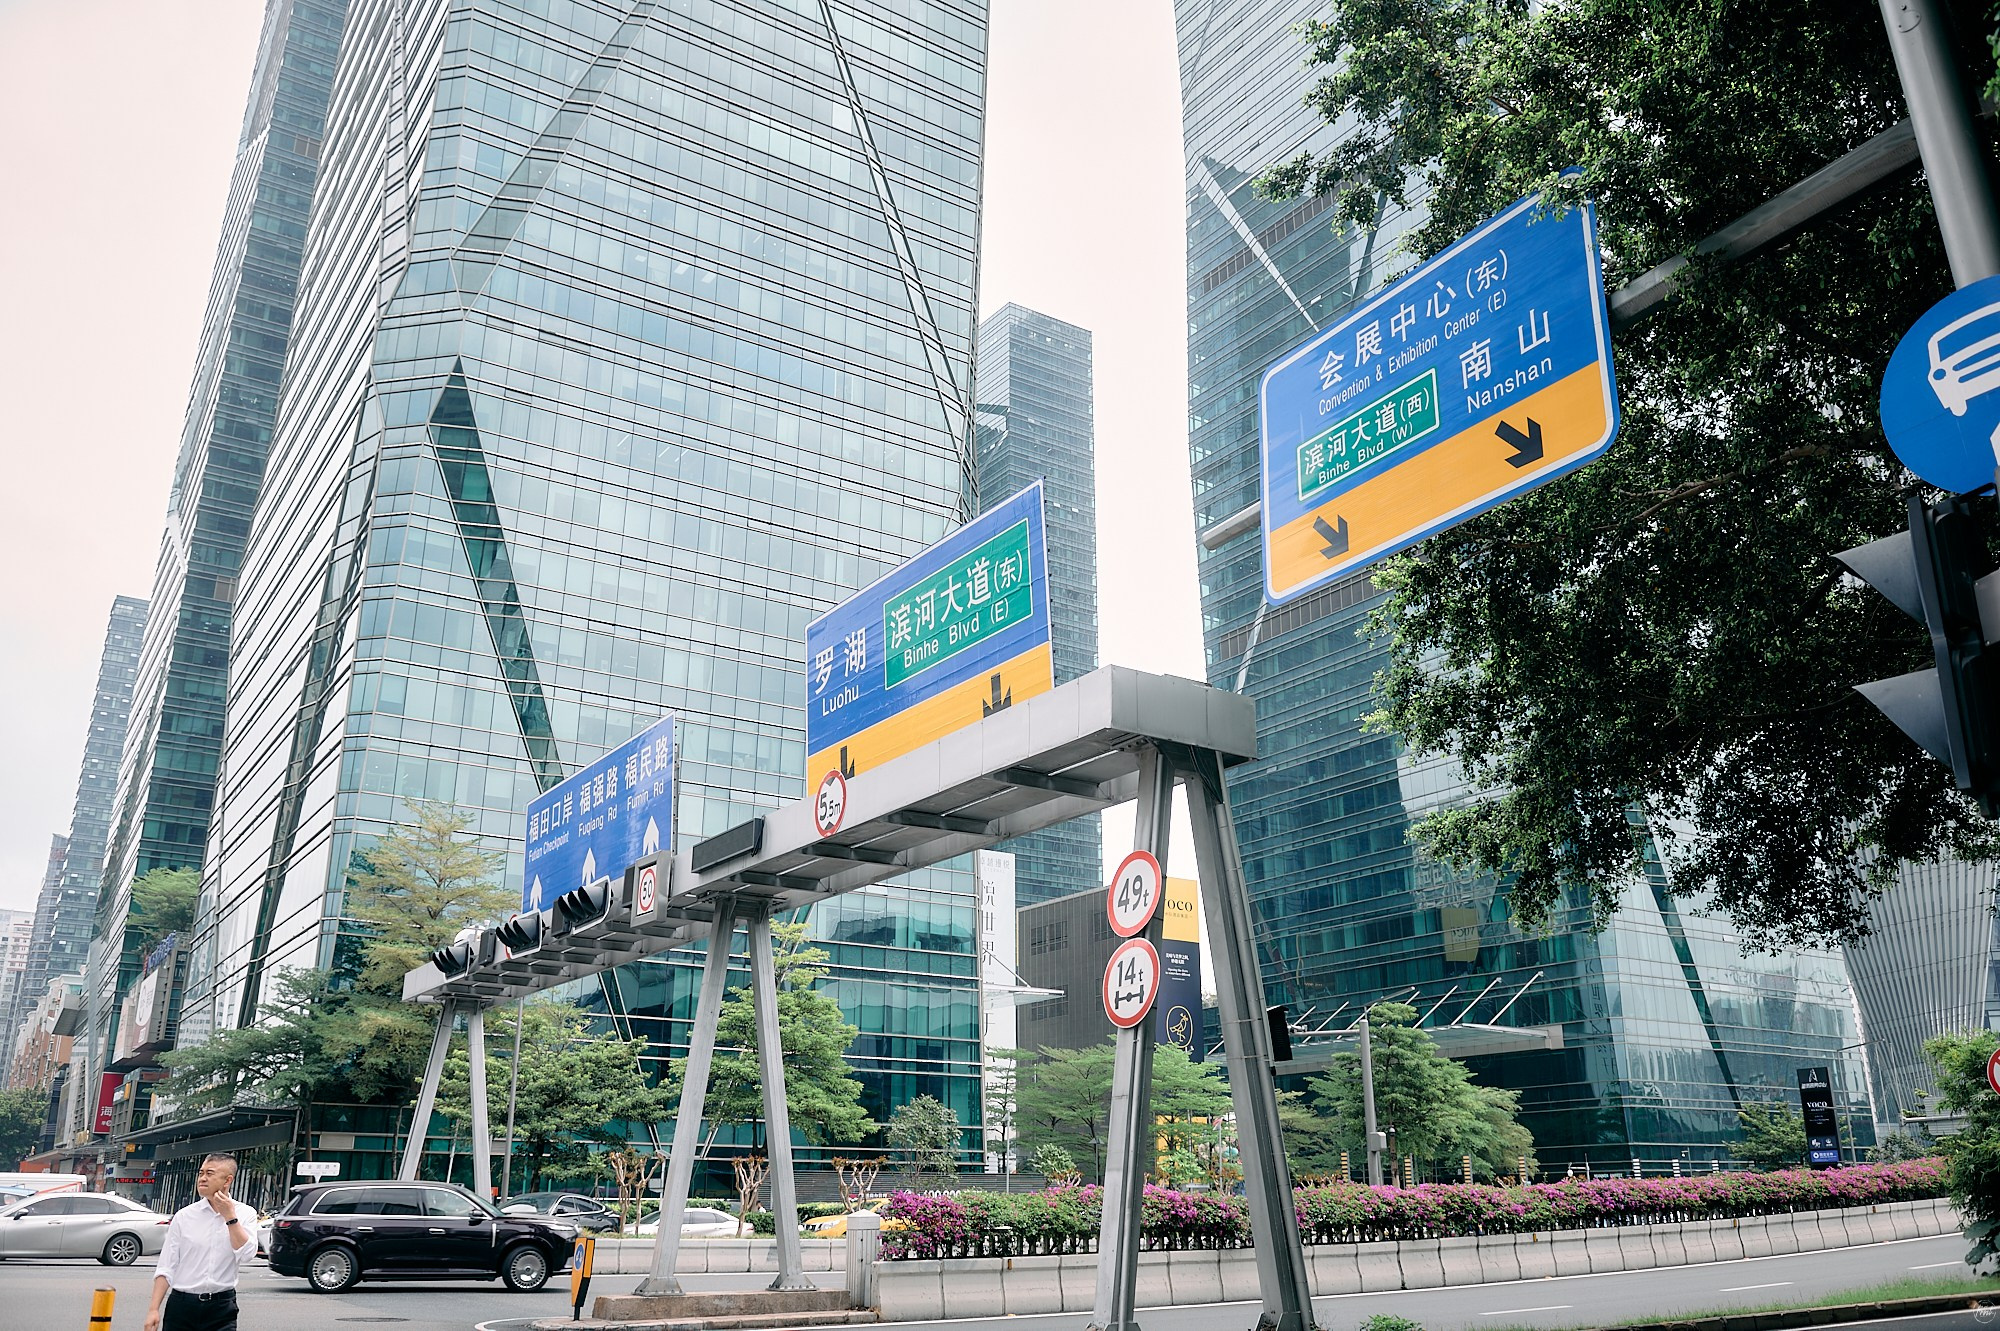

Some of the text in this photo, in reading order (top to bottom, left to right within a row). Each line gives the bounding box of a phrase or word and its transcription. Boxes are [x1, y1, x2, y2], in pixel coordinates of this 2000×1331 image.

[1319, 289, 1507, 416] Convention & Exhibition Center (E)
[1459, 308, 1551, 389] 南山
[1467, 357, 1553, 414] Nanshan
[1318, 422, 1413, 484] Binhe Blvd (W)
[904, 600, 1009, 669] Binhe Blvd (E)
[814, 627, 867, 695] 罗湖
[822, 687, 859, 716] Luohu
[529, 734, 668, 844] 福田口岸 福强路 福民路
[627, 782, 664, 811] Fumin Rd
[819, 793, 841, 820] 5.5m
[578, 804, 617, 837] Fuqiang Rd
[528, 830, 569, 863] Futian Checkpoint
[642, 879, 654, 901] 50
[1164, 898, 1193, 912] OCO
